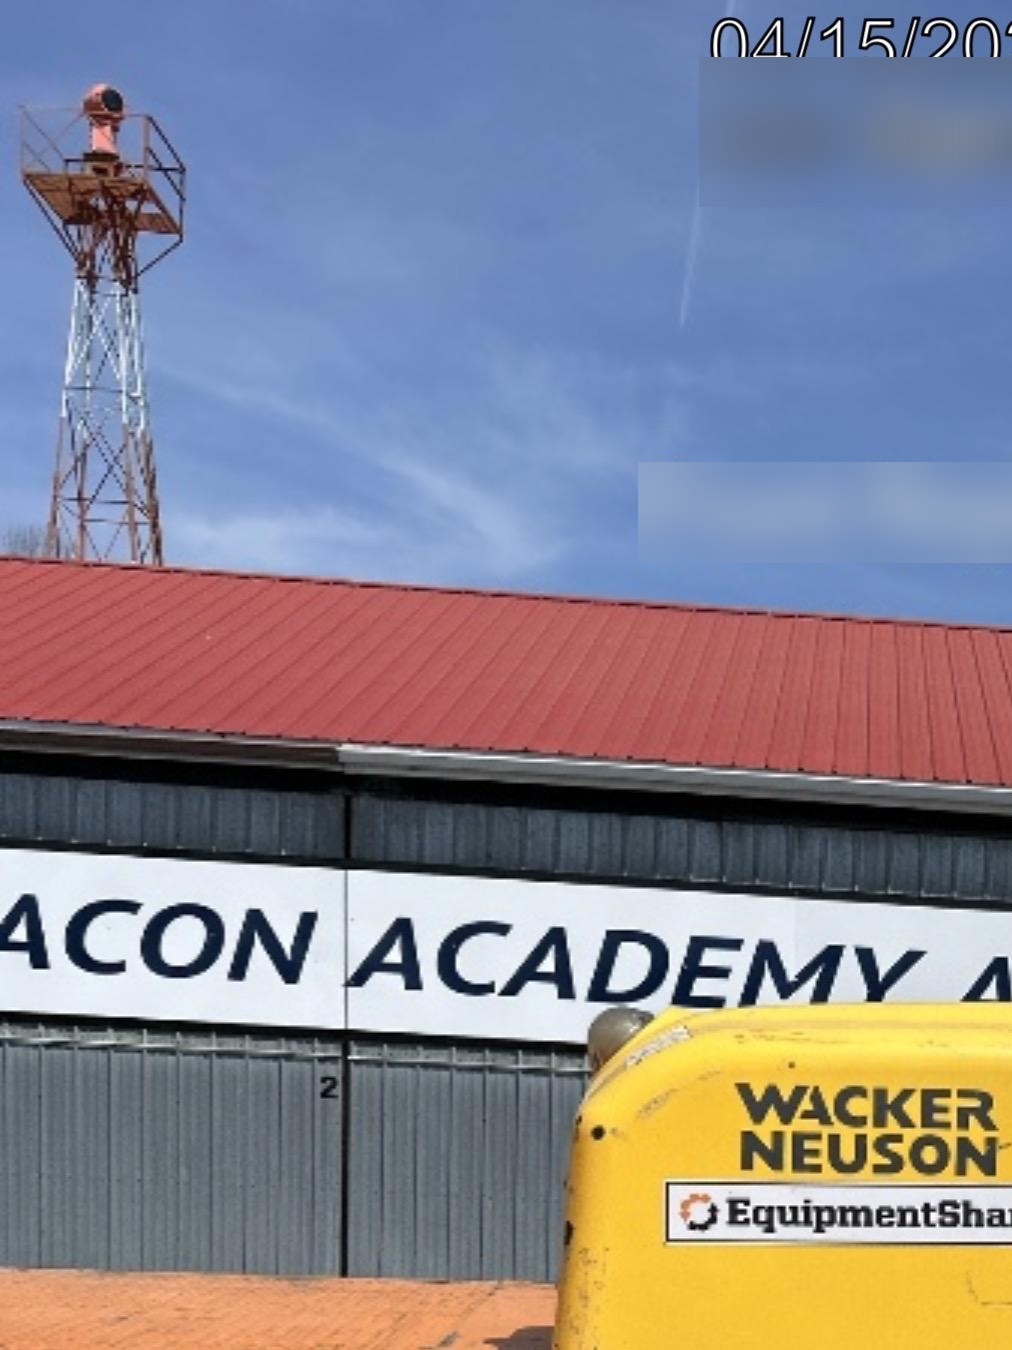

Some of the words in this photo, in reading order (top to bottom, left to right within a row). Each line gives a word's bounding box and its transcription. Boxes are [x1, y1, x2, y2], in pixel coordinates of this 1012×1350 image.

[0, 893, 318, 985] ACON
[344, 917, 927, 1009] ACADEMY
[320, 1077, 339, 1099] 2
[735, 1082, 1000, 1131] WACKER
[740, 1130, 998, 1176] NEUSON
